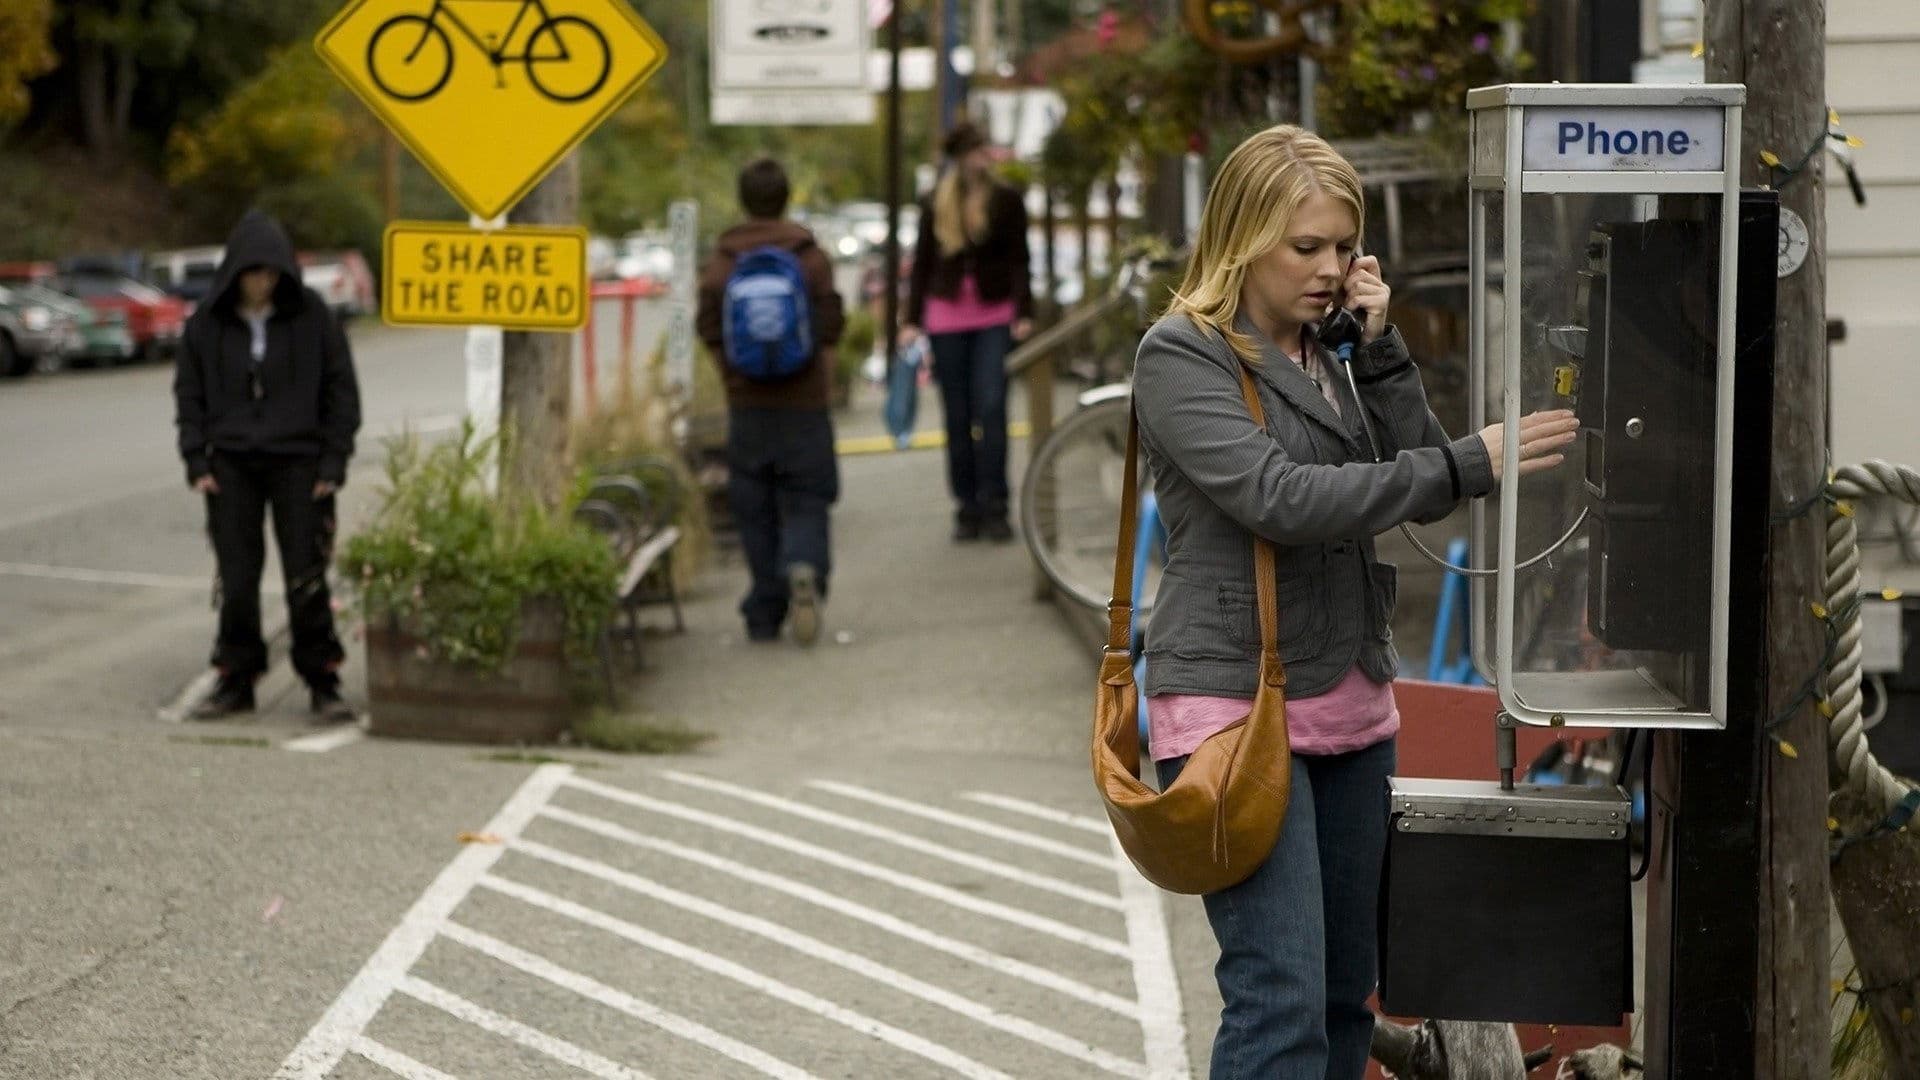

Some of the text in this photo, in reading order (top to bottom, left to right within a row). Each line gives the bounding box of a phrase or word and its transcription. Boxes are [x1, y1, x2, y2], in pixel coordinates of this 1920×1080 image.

[1558, 122, 1690, 155] Phone
[421, 241, 552, 276] SHARE
[400, 277, 575, 315] THE ROAD
